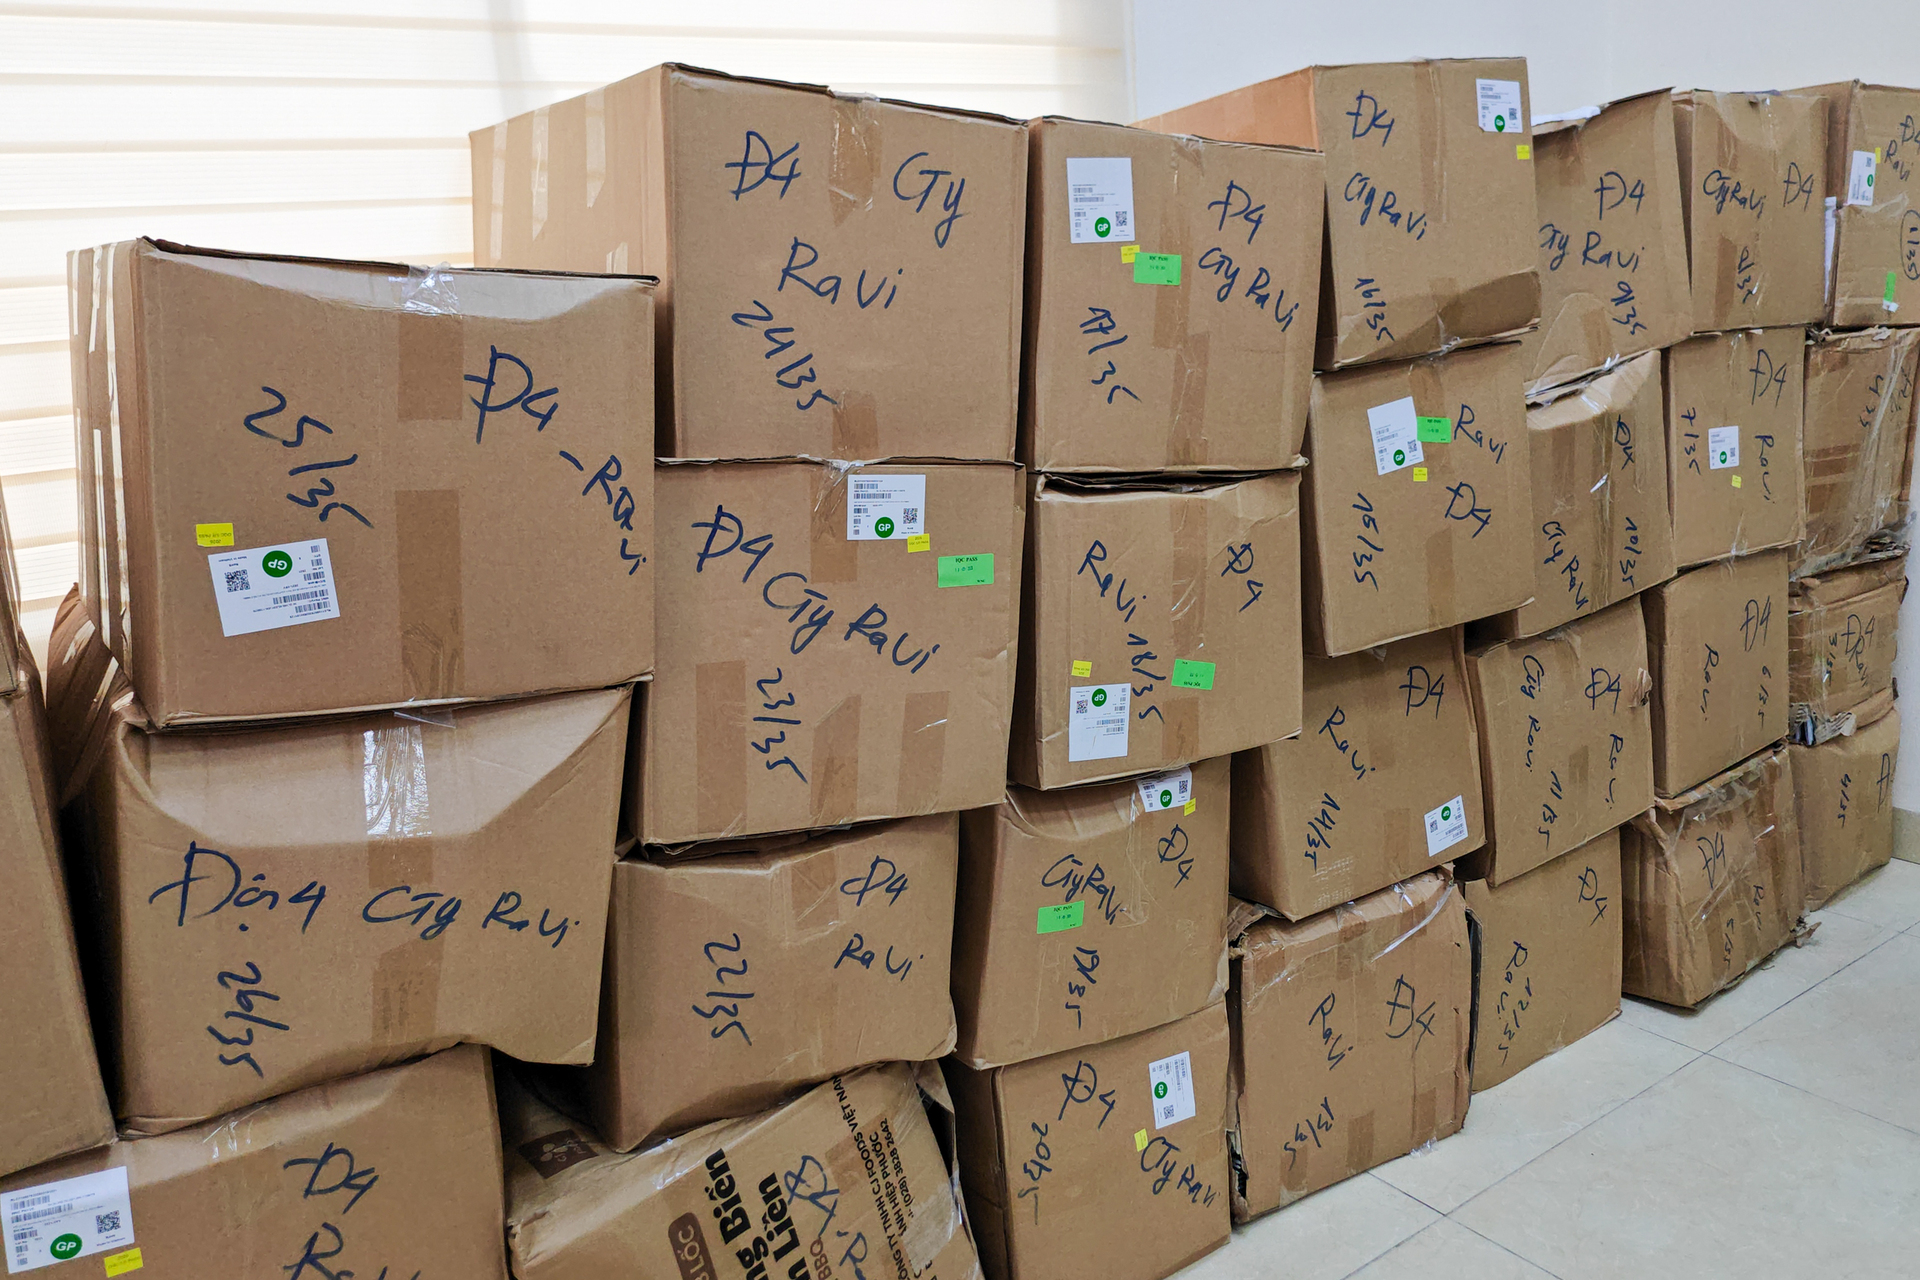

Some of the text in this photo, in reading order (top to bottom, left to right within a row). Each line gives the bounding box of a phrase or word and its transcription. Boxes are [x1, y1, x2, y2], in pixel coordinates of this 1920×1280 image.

[841, 1103, 859, 1133] VIỆT
[880, 1117, 895, 1148] 2642
[854, 1132, 877, 1178] FOODS
[890, 1147, 903, 1177] 3828
[870, 1178, 881, 1195] CJ
[875, 1195, 892, 1233] TNHH
[887, 1233, 898, 1250] TY
[893, 1249, 910, 1280] ÔNG
